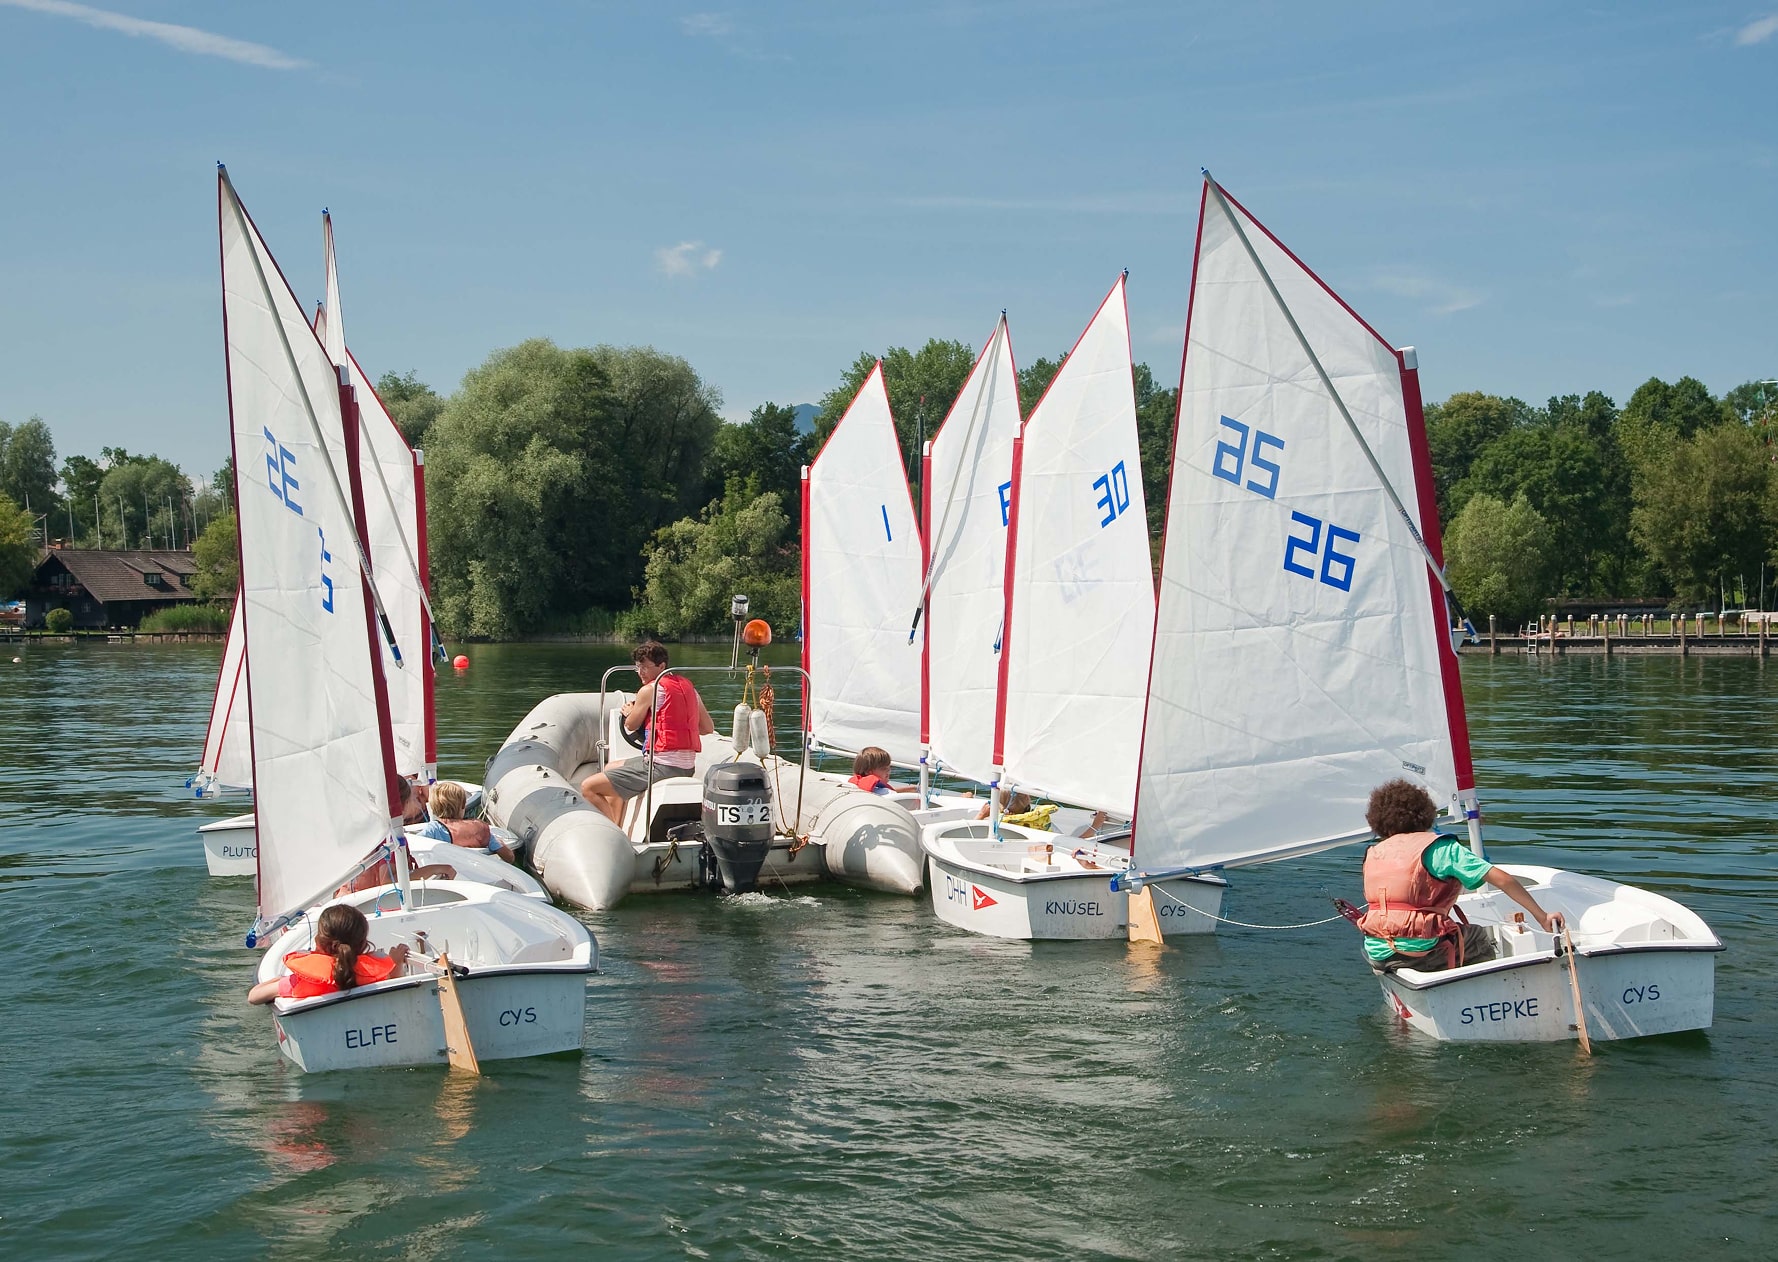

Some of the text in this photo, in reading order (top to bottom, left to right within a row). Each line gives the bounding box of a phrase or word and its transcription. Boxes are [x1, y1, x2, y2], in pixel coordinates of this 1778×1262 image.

[1092, 460, 1129, 528] 30
[1283, 511, 1360, 592] 26
[718, 806, 741, 823] TS
[946, 875, 968, 907] DHH
[1045, 899, 1186, 917] KNÜSEL CYS
[1460, 985, 1661, 1025] STEPKE CYS
[345, 1007, 537, 1049] ELFE CYS
